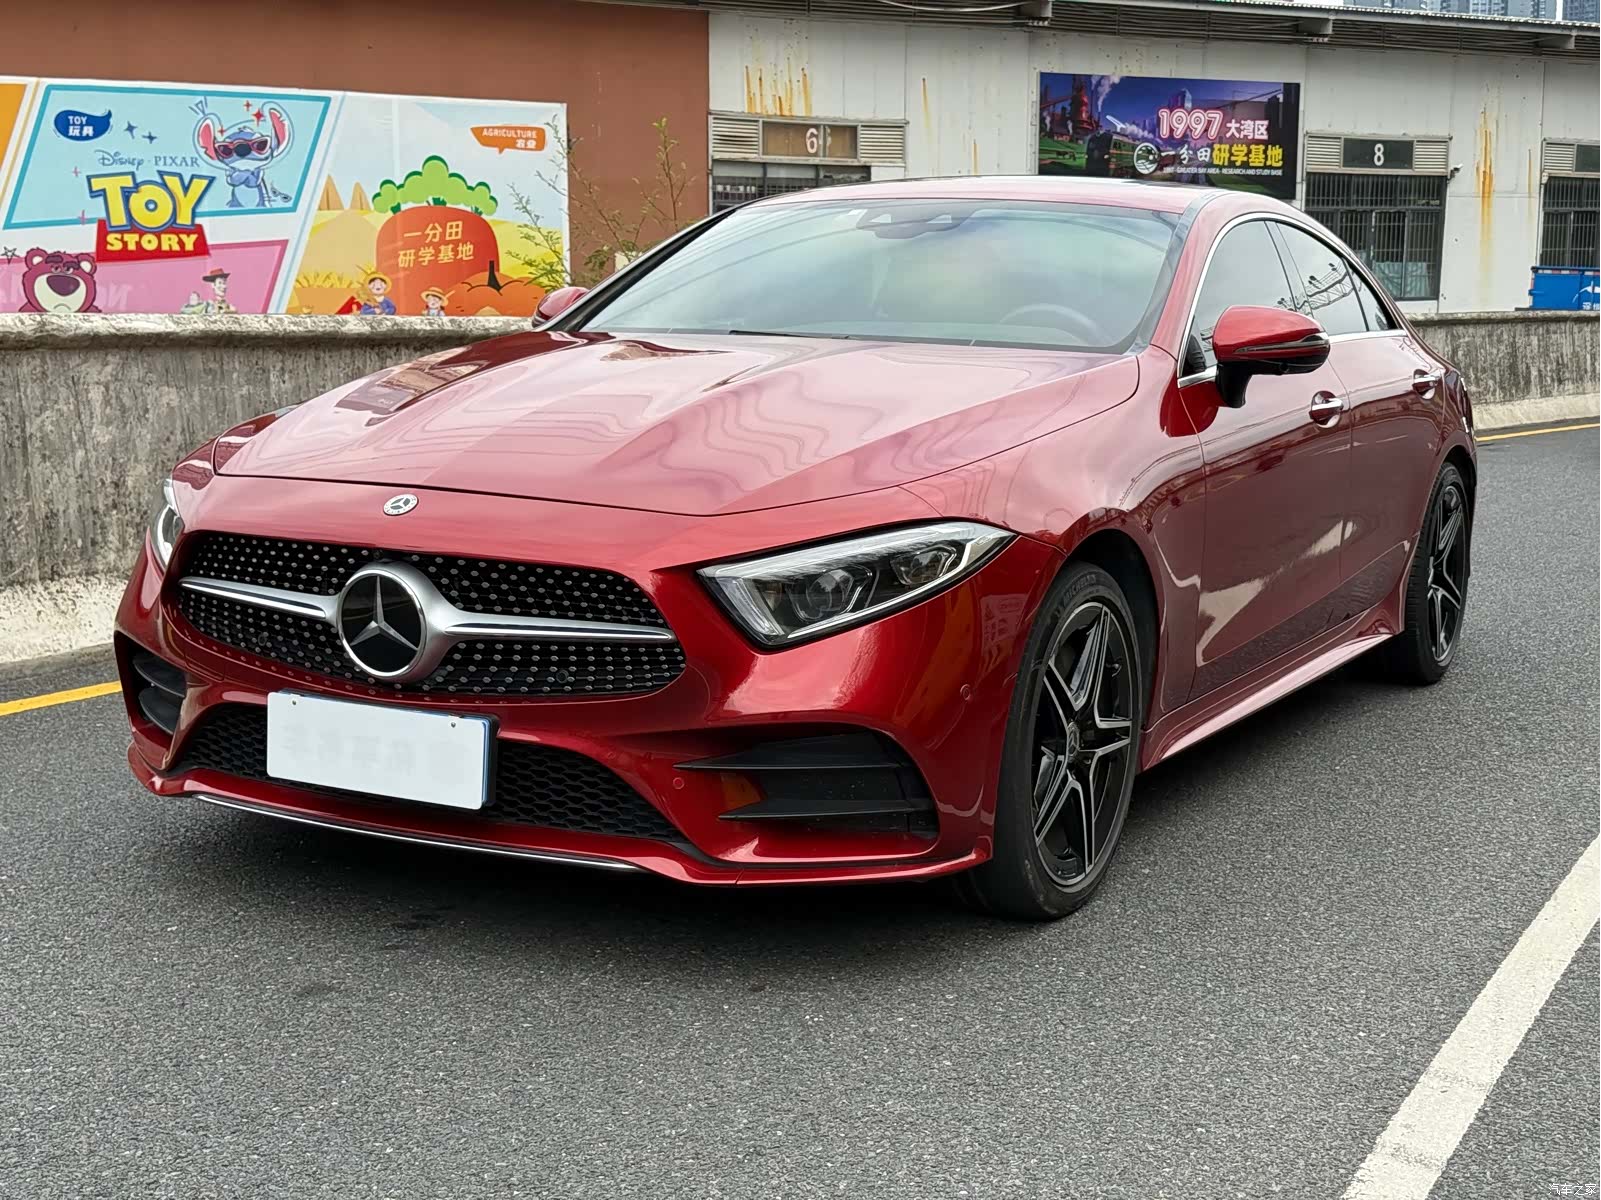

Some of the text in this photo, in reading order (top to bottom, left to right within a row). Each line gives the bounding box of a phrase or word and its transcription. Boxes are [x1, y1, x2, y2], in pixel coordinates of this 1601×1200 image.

[67, 115, 88, 125] TOY
[68, 125, 94, 137] 玩具
[1159, 109, 1268, 139] 1997 大湾区
[482, 128, 537, 139] AGRICULTURE
[94, 149, 200, 171] Disney PIXAR
[1373, 143, 1385, 166] 8
[86, 170, 215, 232] TOY
[106, 233, 199, 251] STORY
[403, 220, 464, 243] 一分田
[398, 241, 475, 268] 研学基地
